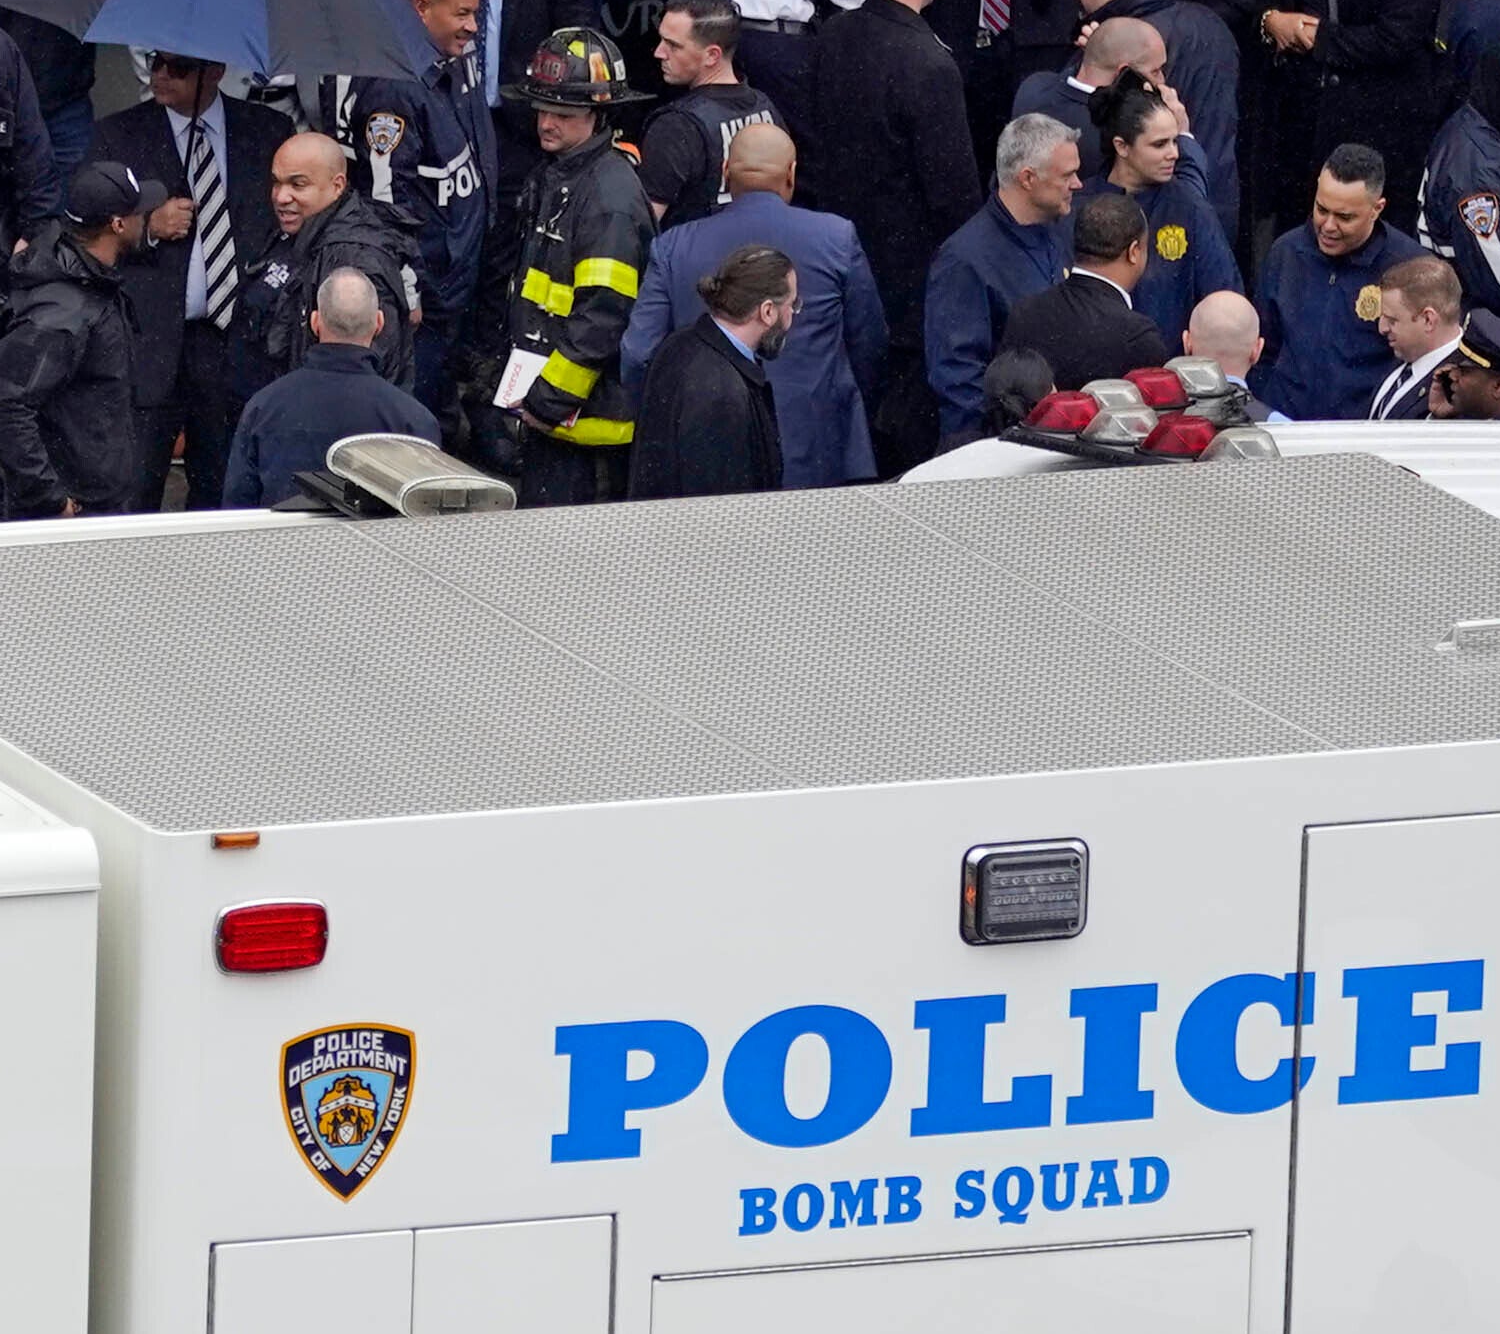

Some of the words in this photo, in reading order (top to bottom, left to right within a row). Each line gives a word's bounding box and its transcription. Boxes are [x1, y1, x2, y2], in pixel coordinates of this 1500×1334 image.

[552, 958, 1485, 1163] POLICE
[738, 1175, 923, 1236] BOMB
[953, 1157, 1172, 1226] SQUAD
